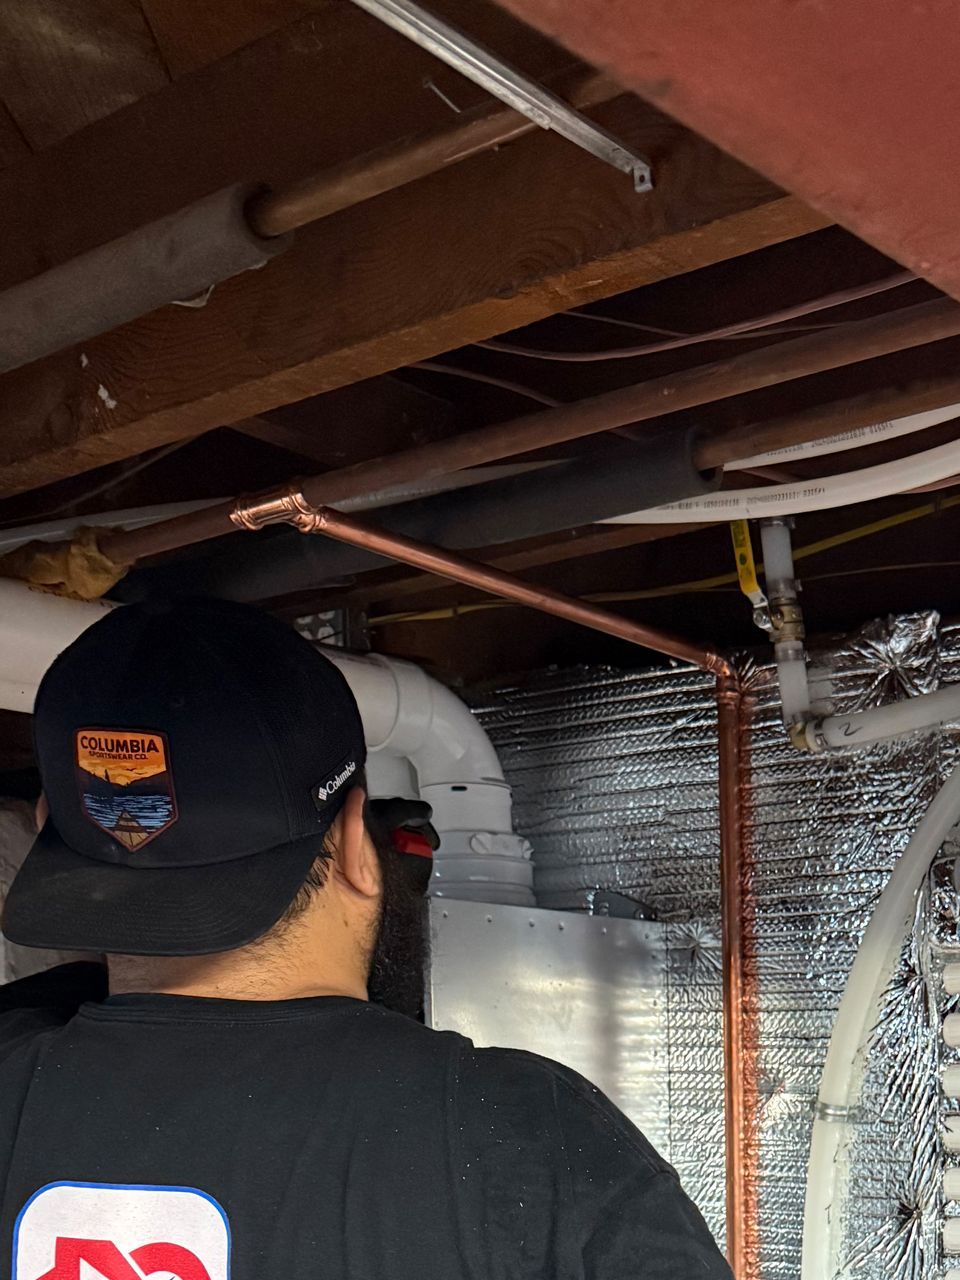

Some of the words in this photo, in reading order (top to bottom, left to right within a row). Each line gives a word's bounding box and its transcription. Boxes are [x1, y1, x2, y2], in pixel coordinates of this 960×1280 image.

[80, 735, 160, 754] COLUMBIA
[88, 750, 134, 761] SPORTSWEAR
[326, 761, 356, 794] Columbia
